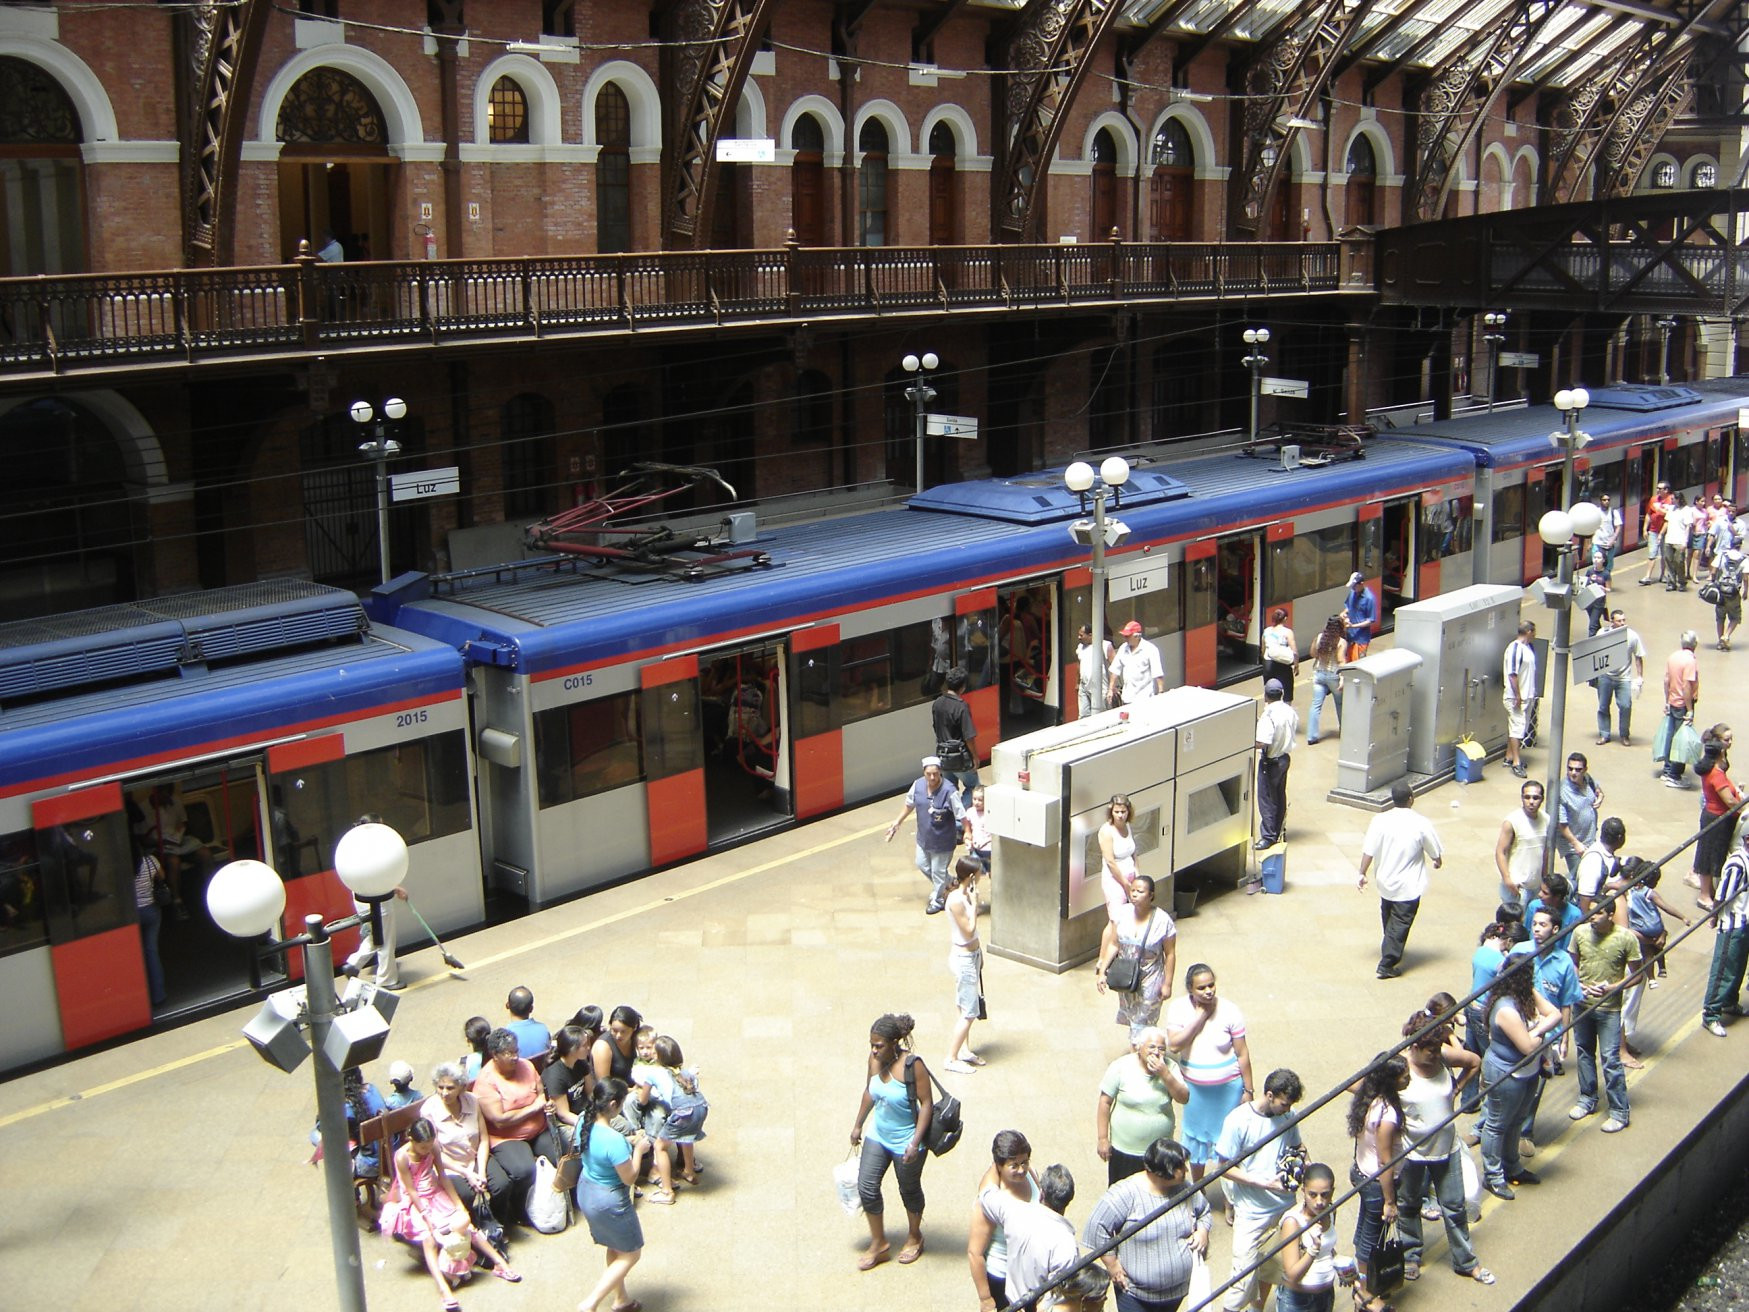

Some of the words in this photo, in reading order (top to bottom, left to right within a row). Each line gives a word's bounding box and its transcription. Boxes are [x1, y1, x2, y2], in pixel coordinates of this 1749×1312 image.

[416, 483, 436, 494] Luz
[1130, 577, 1147, 592] Luz
[1593, 654, 1609, 671] Luz
[396, 710, 428, 727] 2015
